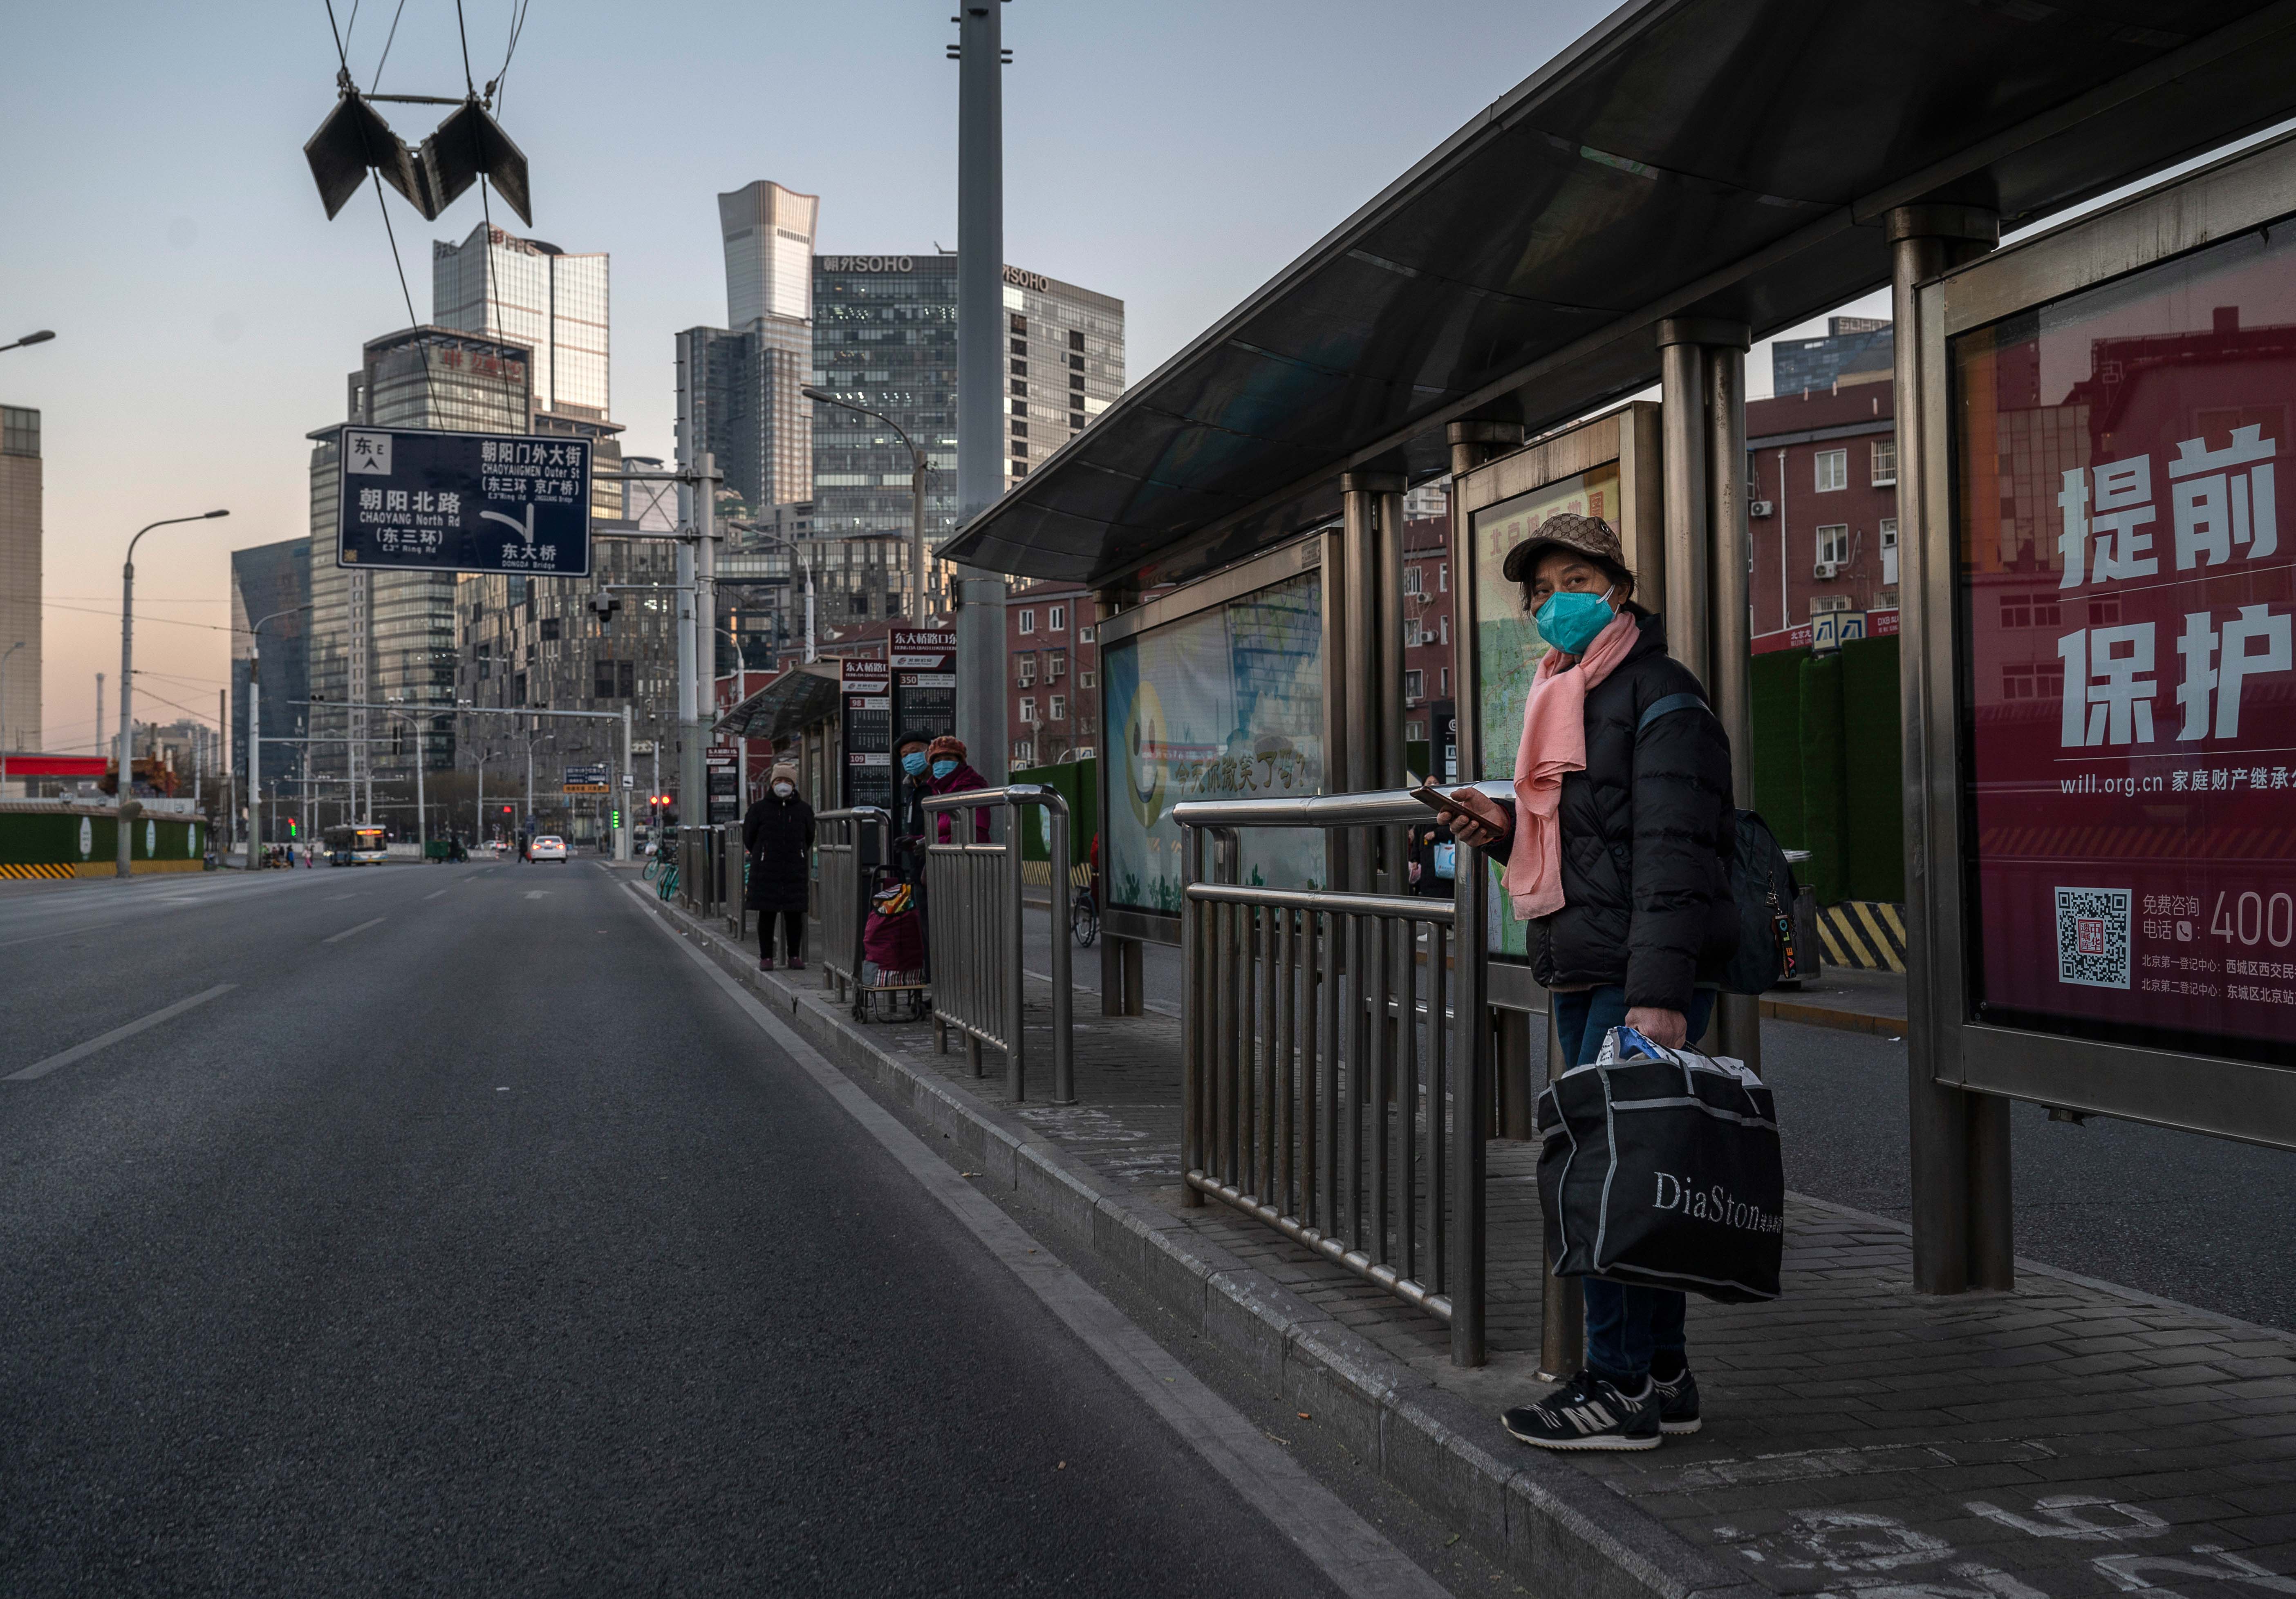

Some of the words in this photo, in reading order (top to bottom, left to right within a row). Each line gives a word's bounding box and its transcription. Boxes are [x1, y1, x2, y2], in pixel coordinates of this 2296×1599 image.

[354, 437, 372, 455] 东
[376, 445, 384, 455] E
[481, 440, 581, 467] 朝阳门外大街
[482, 463, 541, 476] CHAOYANGMEN
[544, 467, 567, 479] Outer
[571, 468, 580, 479] St
[359, 488, 461, 514] 朝阳北路
[2058, 423, 2278, 590] 提前
[359, 511, 412, 525] CHAOYANG
[416, 513, 443, 526] North
[448, 515, 460, 527] Rd
[376, 527, 443, 545] (东三环)
[502, 543, 556, 561] 东大桥
[533, 561, 556, 570] Bridge
[2058, 604, 2292, 747] 保护
[2061, 774, 2163, 797] will.org.cn
[2143, 893, 2199, 917] 免费咨询
[2210, 891, 2293, 947] 400
[1652, 1172, 1759, 1231] DiaSton
